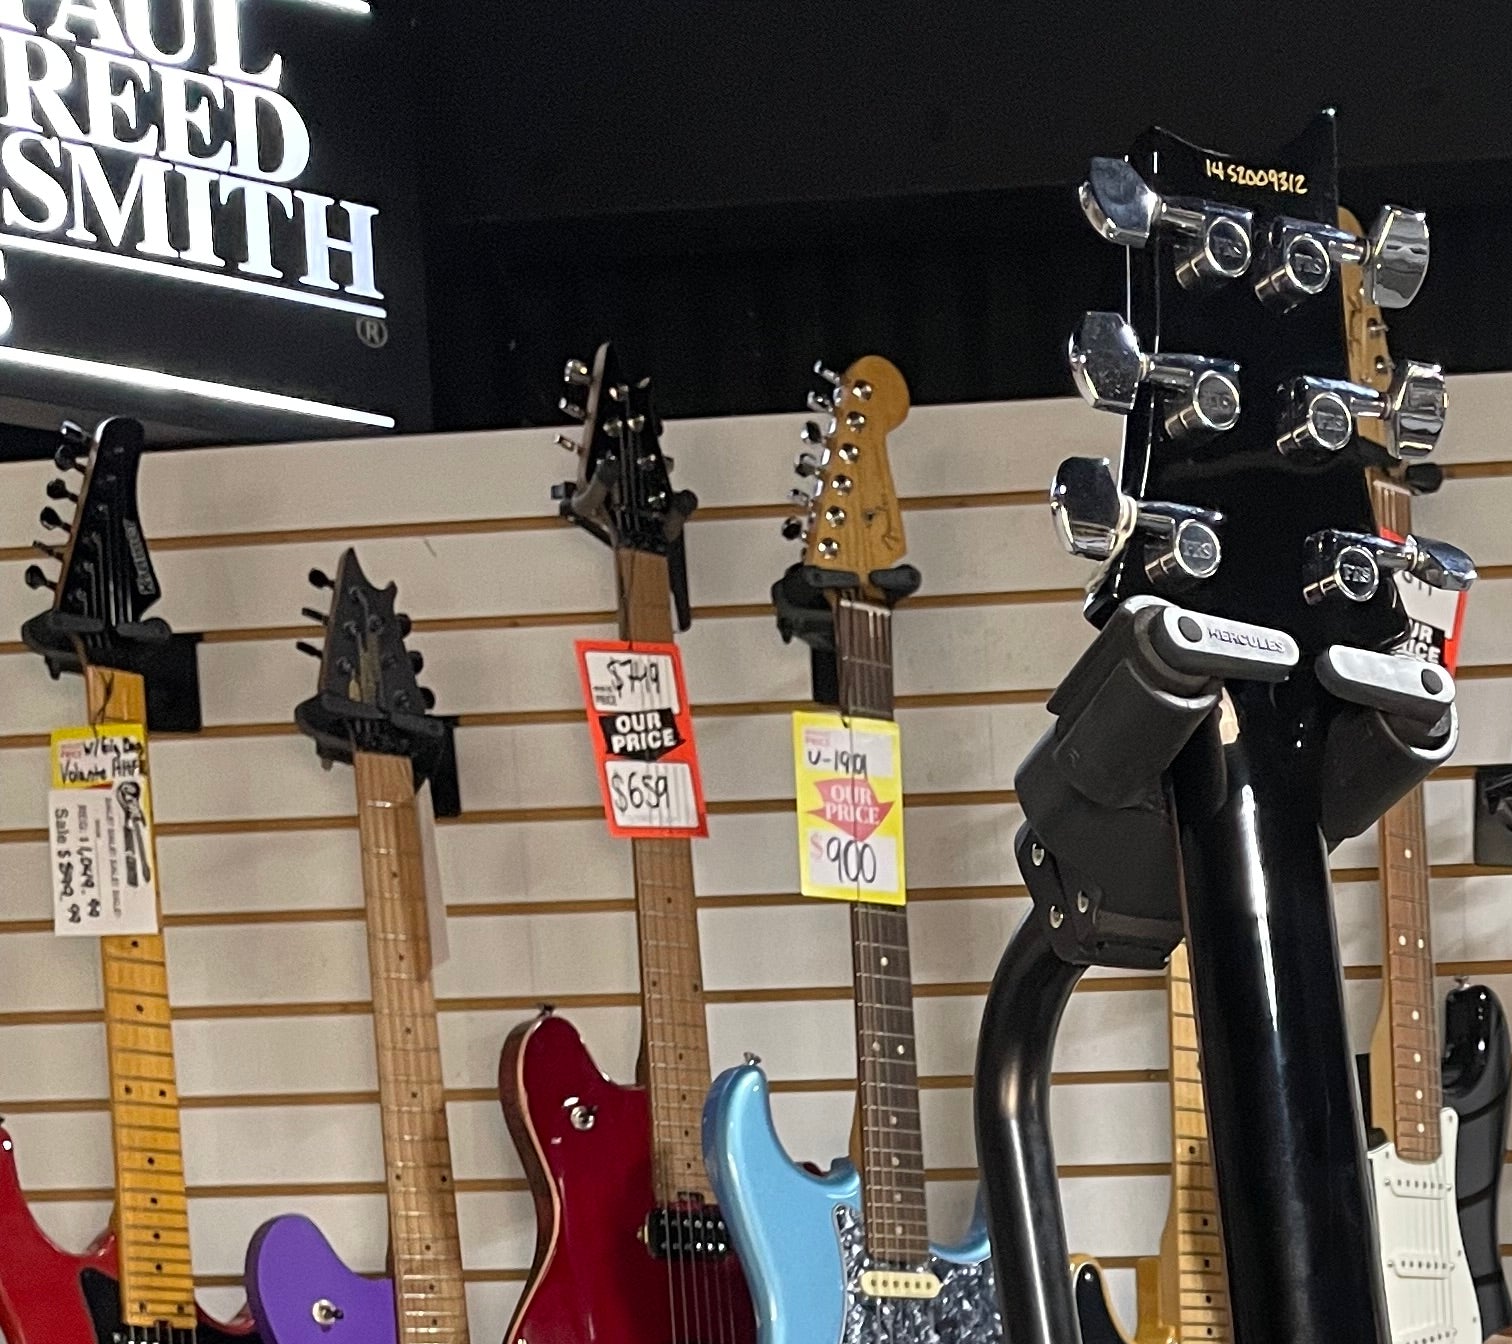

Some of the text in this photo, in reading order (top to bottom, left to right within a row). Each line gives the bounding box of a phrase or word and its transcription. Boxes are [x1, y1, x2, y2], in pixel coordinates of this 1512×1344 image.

[0, 0, 283, 89] AUL
[0, 28, 311, 184] REED
[0, 130, 385, 300] SMITH
[1207, 628, 1285, 653] HERCULES
[615, 711, 662, 732] OUR
[610, 726, 676, 754] PRICE
[610, 771, 669, 813] $659
[831, 782, 873, 804] OUR
[55, 808, 69, 843] Sale
[825, 799, 880, 826] PRICE
[811, 837, 878, 883] $900
